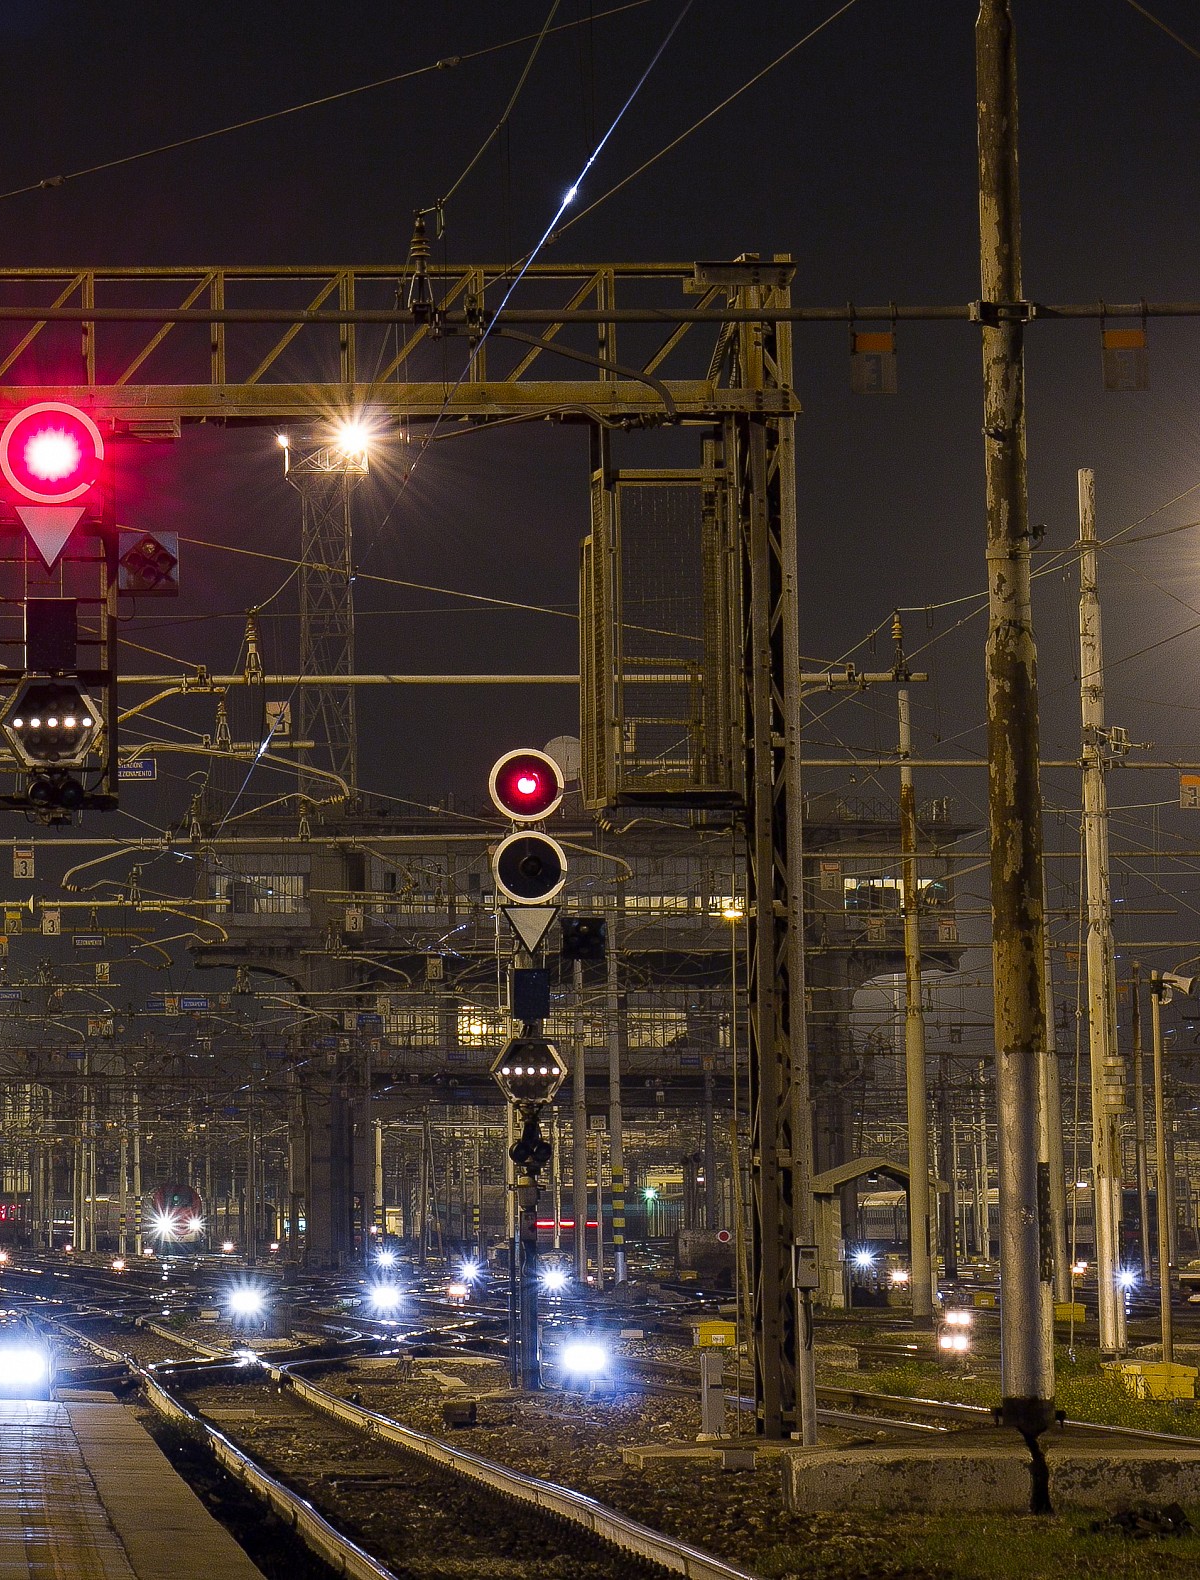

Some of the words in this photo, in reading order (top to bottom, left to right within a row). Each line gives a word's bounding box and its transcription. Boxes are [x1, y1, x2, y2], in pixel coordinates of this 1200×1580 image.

[20, 860, 28, 876] 3
[10, 920, 17, 933] 2
[48, 920, 55, 933] 3
[351, 917, 358, 930] 3
